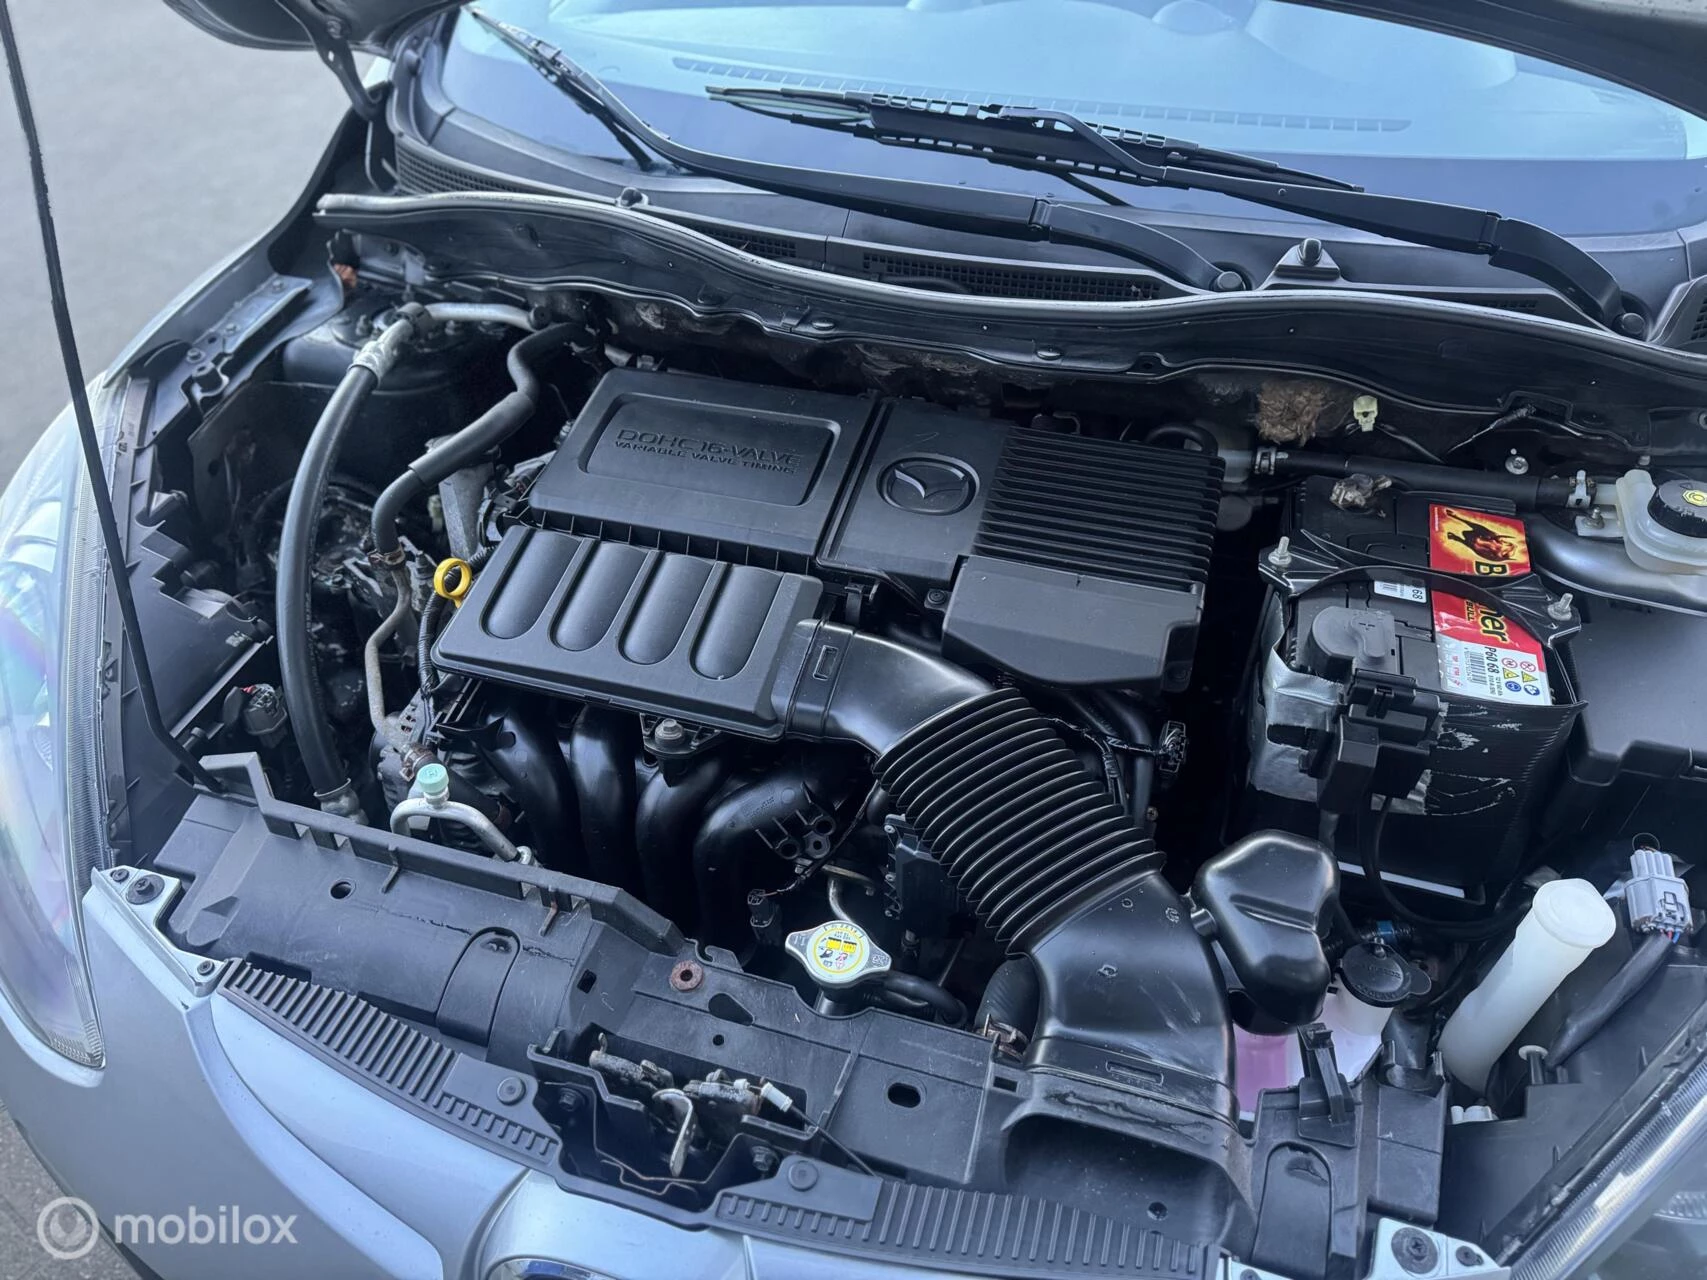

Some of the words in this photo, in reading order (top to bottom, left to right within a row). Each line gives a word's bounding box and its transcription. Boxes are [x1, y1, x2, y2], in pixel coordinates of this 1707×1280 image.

[617, 428, 700, 451] DOHC
[614, 440, 687, 459] VARIABLE
[691, 452, 738, 467] VALVE
[742, 460, 798, 475] TIMING
[1485, 646, 1498, 662] P60
[1487, 662, 1500, 674] 68
